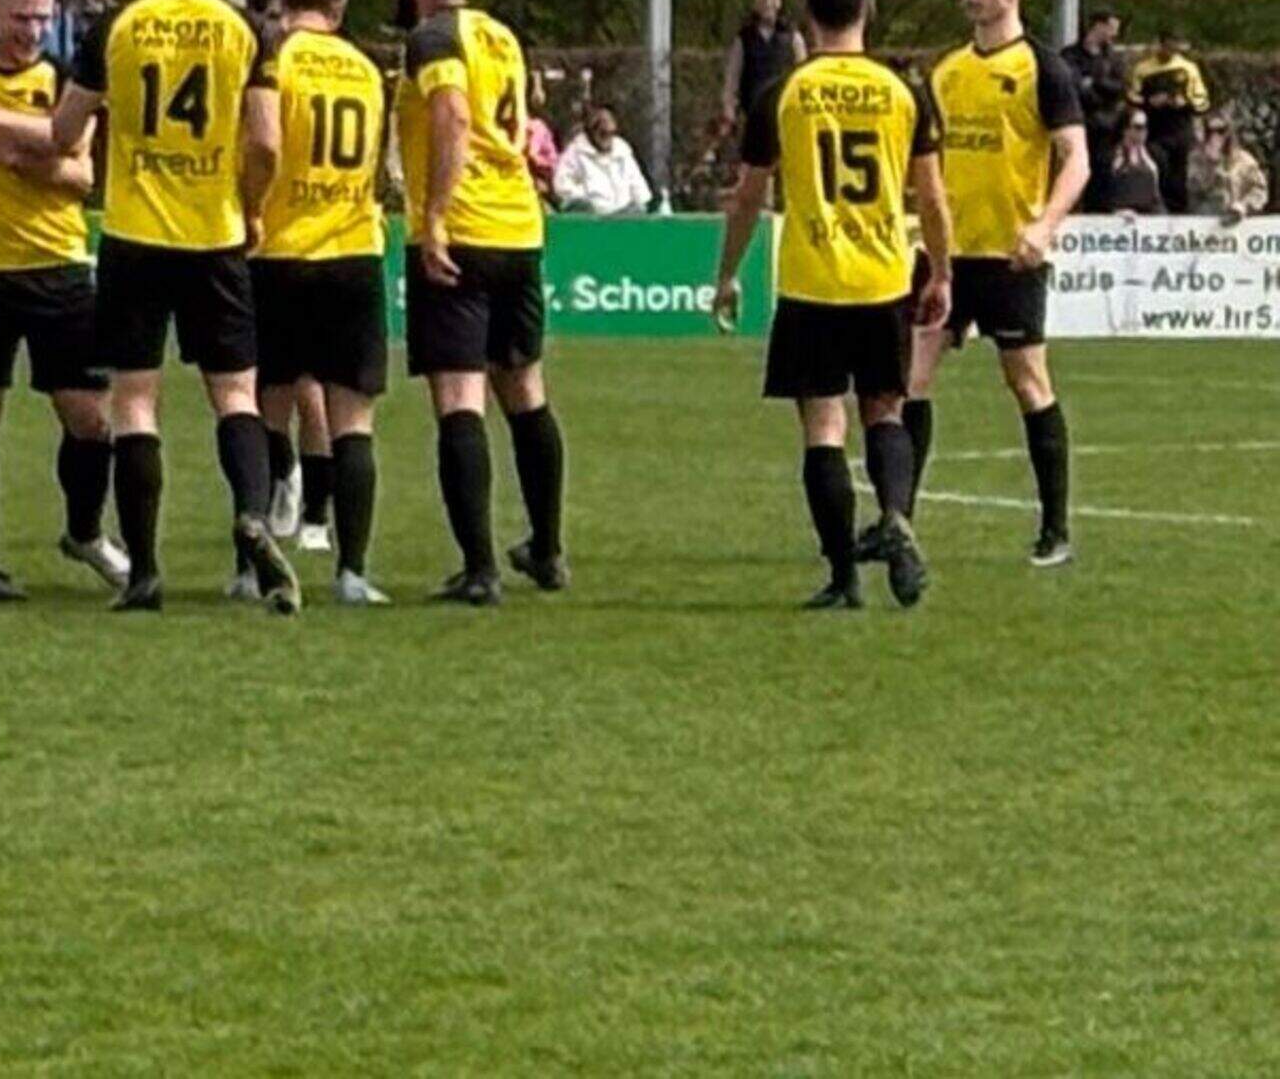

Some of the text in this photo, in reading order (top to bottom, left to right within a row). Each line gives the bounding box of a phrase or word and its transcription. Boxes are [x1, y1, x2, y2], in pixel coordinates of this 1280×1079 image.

[141, 61, 211, 141] 14
[494, 76, 519, 145] 4
[798, 82, 892, 106] KNOPS
[309, 93, 367, 170] 10
[817, 129, 880, 205] 15
[572, 274, 715, 312] Schone
[1151, 265, 1226, 293] Arbo
